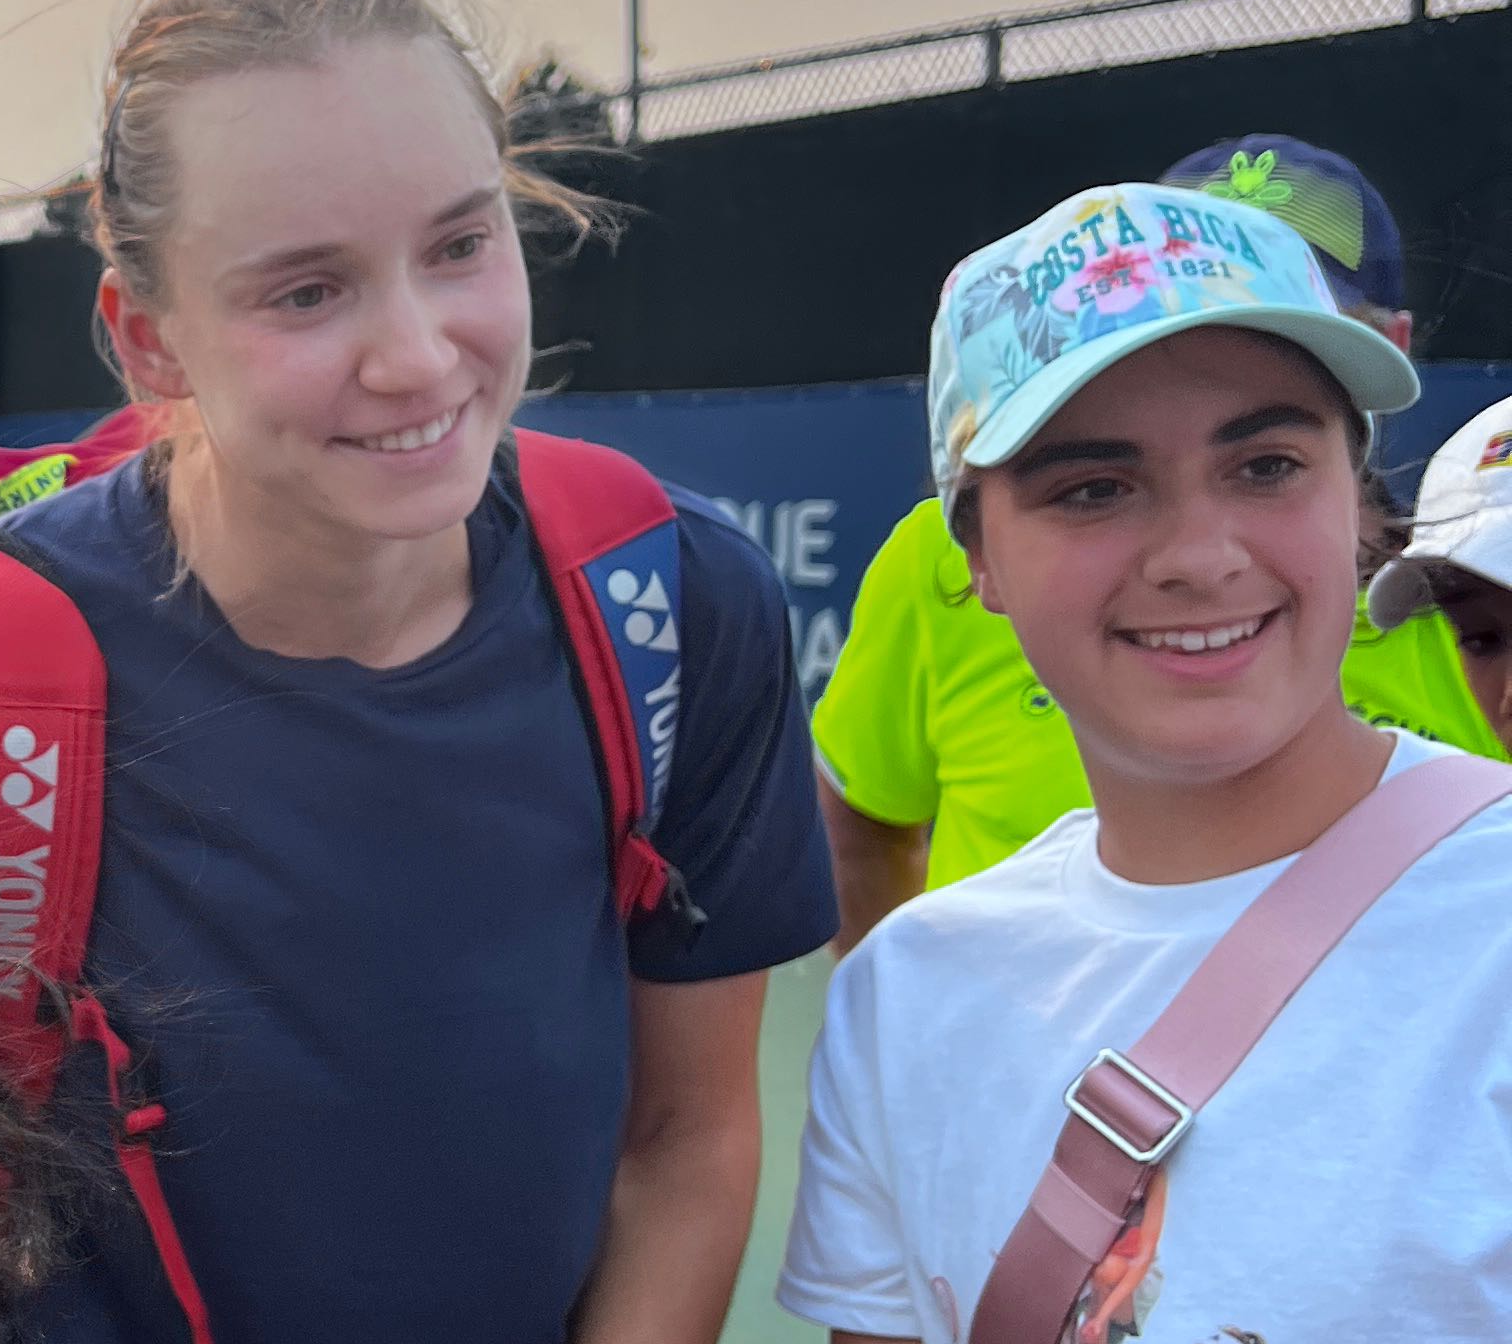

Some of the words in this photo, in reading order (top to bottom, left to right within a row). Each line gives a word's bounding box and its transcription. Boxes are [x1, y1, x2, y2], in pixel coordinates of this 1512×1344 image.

[1026, 206, 1145, 306] COSTA
[1155, 202, 1266, 272] RICA
[1163, 259, 1233, 279] 1821
